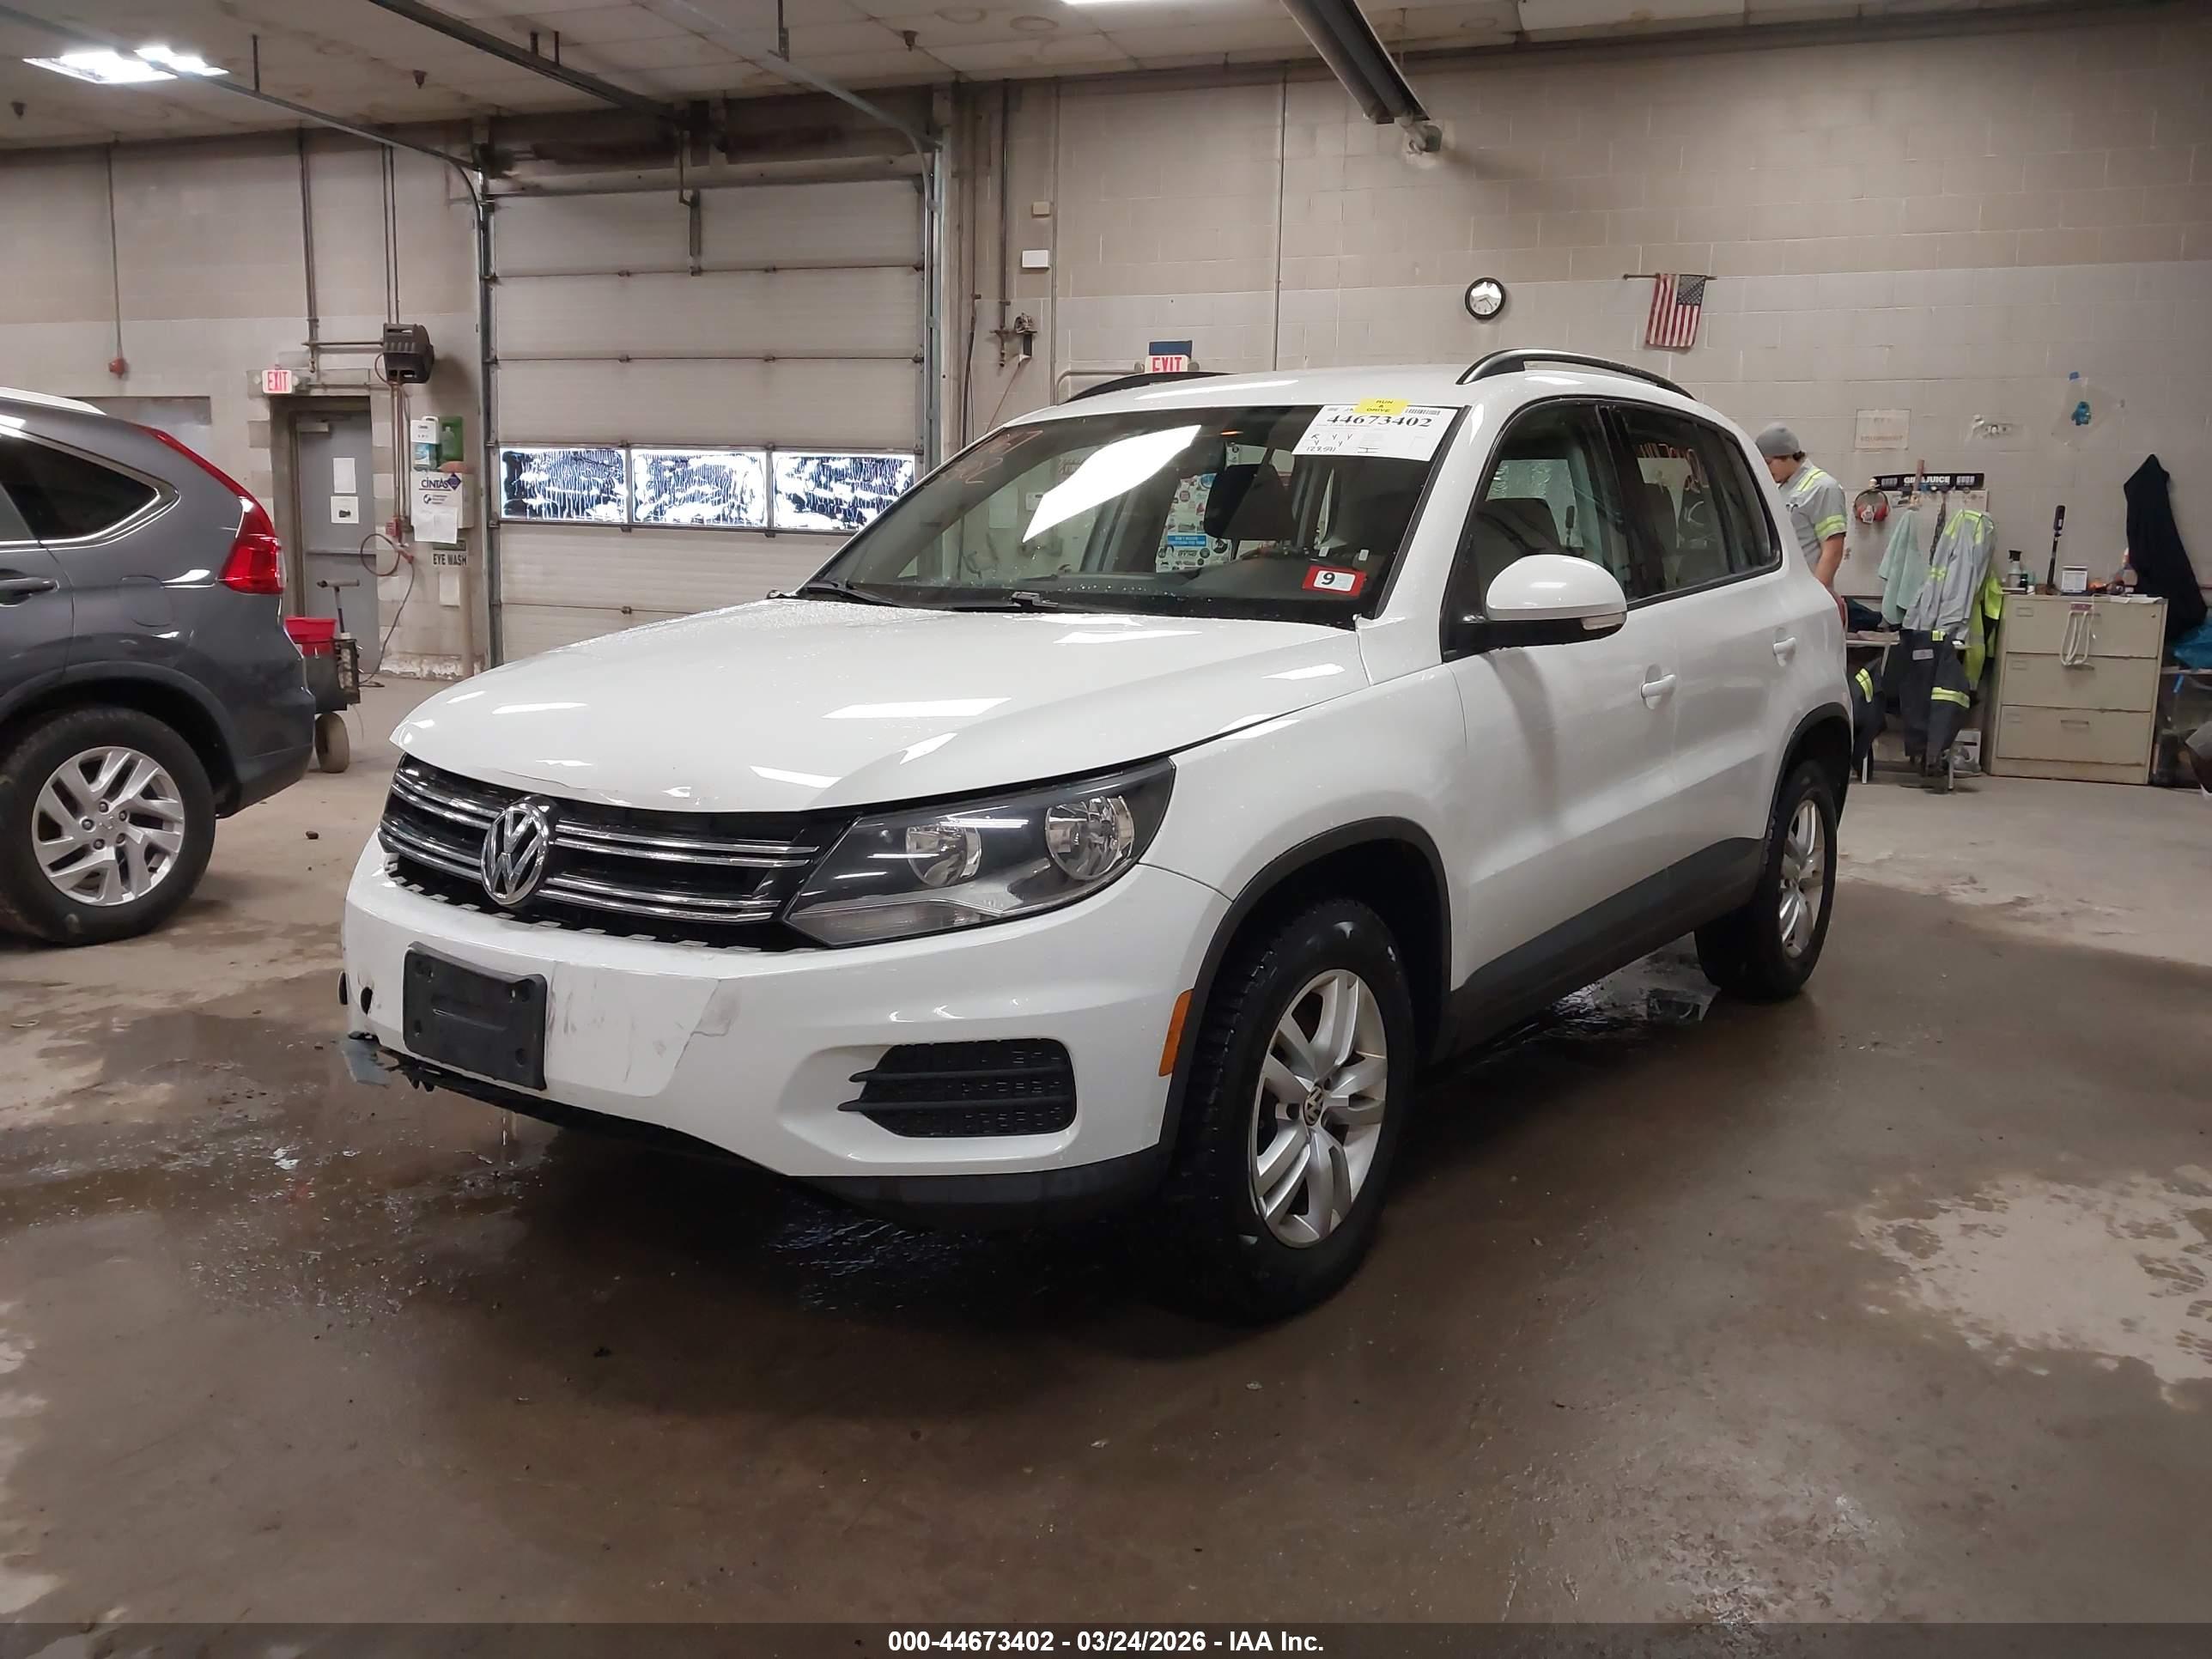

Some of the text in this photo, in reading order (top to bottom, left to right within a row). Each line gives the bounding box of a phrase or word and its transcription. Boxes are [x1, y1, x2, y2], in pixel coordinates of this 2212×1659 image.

[1152, 357, 1182, 372] EXIT
[267, 371, 289, 392] EXIT
[1326, 415, 1432, 428] 44673402
[433, 554, 467, 566] EYE WASH
[1321, 572, 1336, 586] 9
